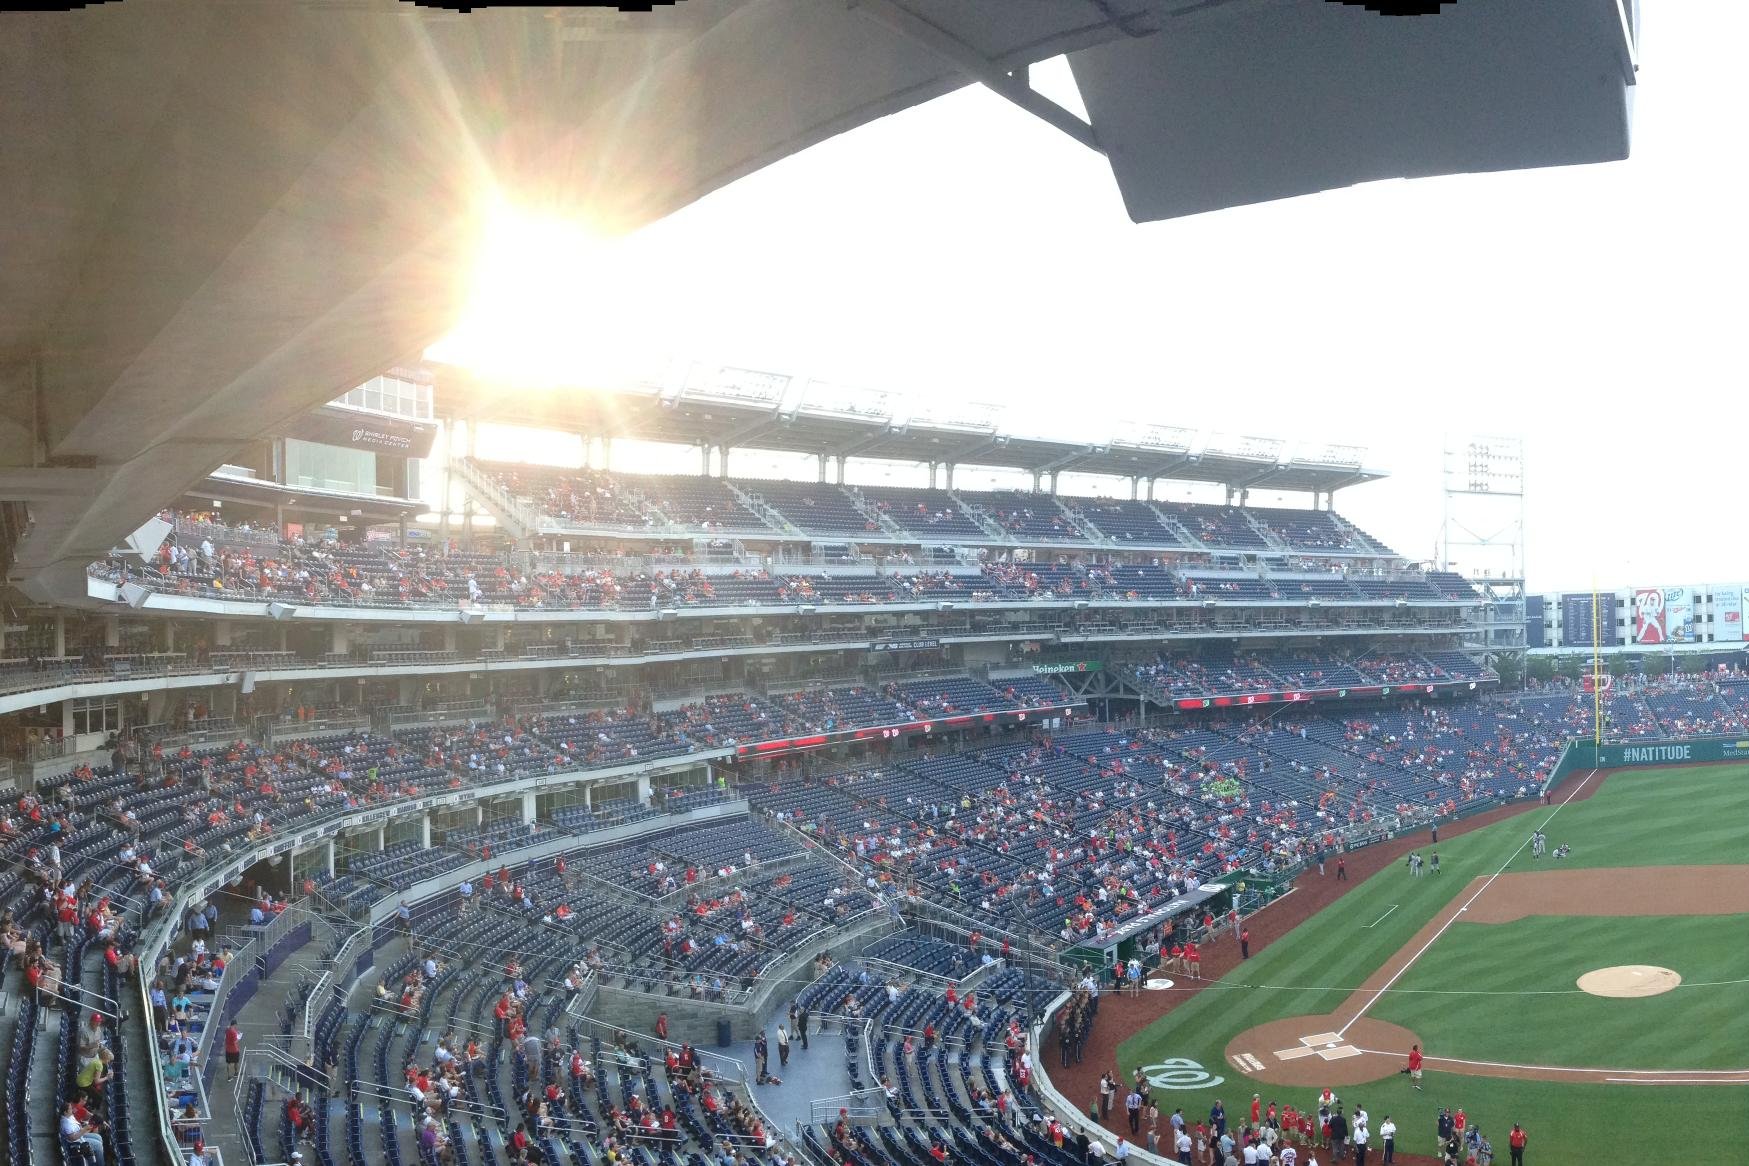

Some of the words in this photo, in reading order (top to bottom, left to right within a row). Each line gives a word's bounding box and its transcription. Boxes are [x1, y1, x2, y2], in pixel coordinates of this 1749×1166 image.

[1033, 663, 1075, 673] Heineken
[1623, 745, 1691, 762] #NATITUDE
[1723, 748, 1749, 757] MedStar
